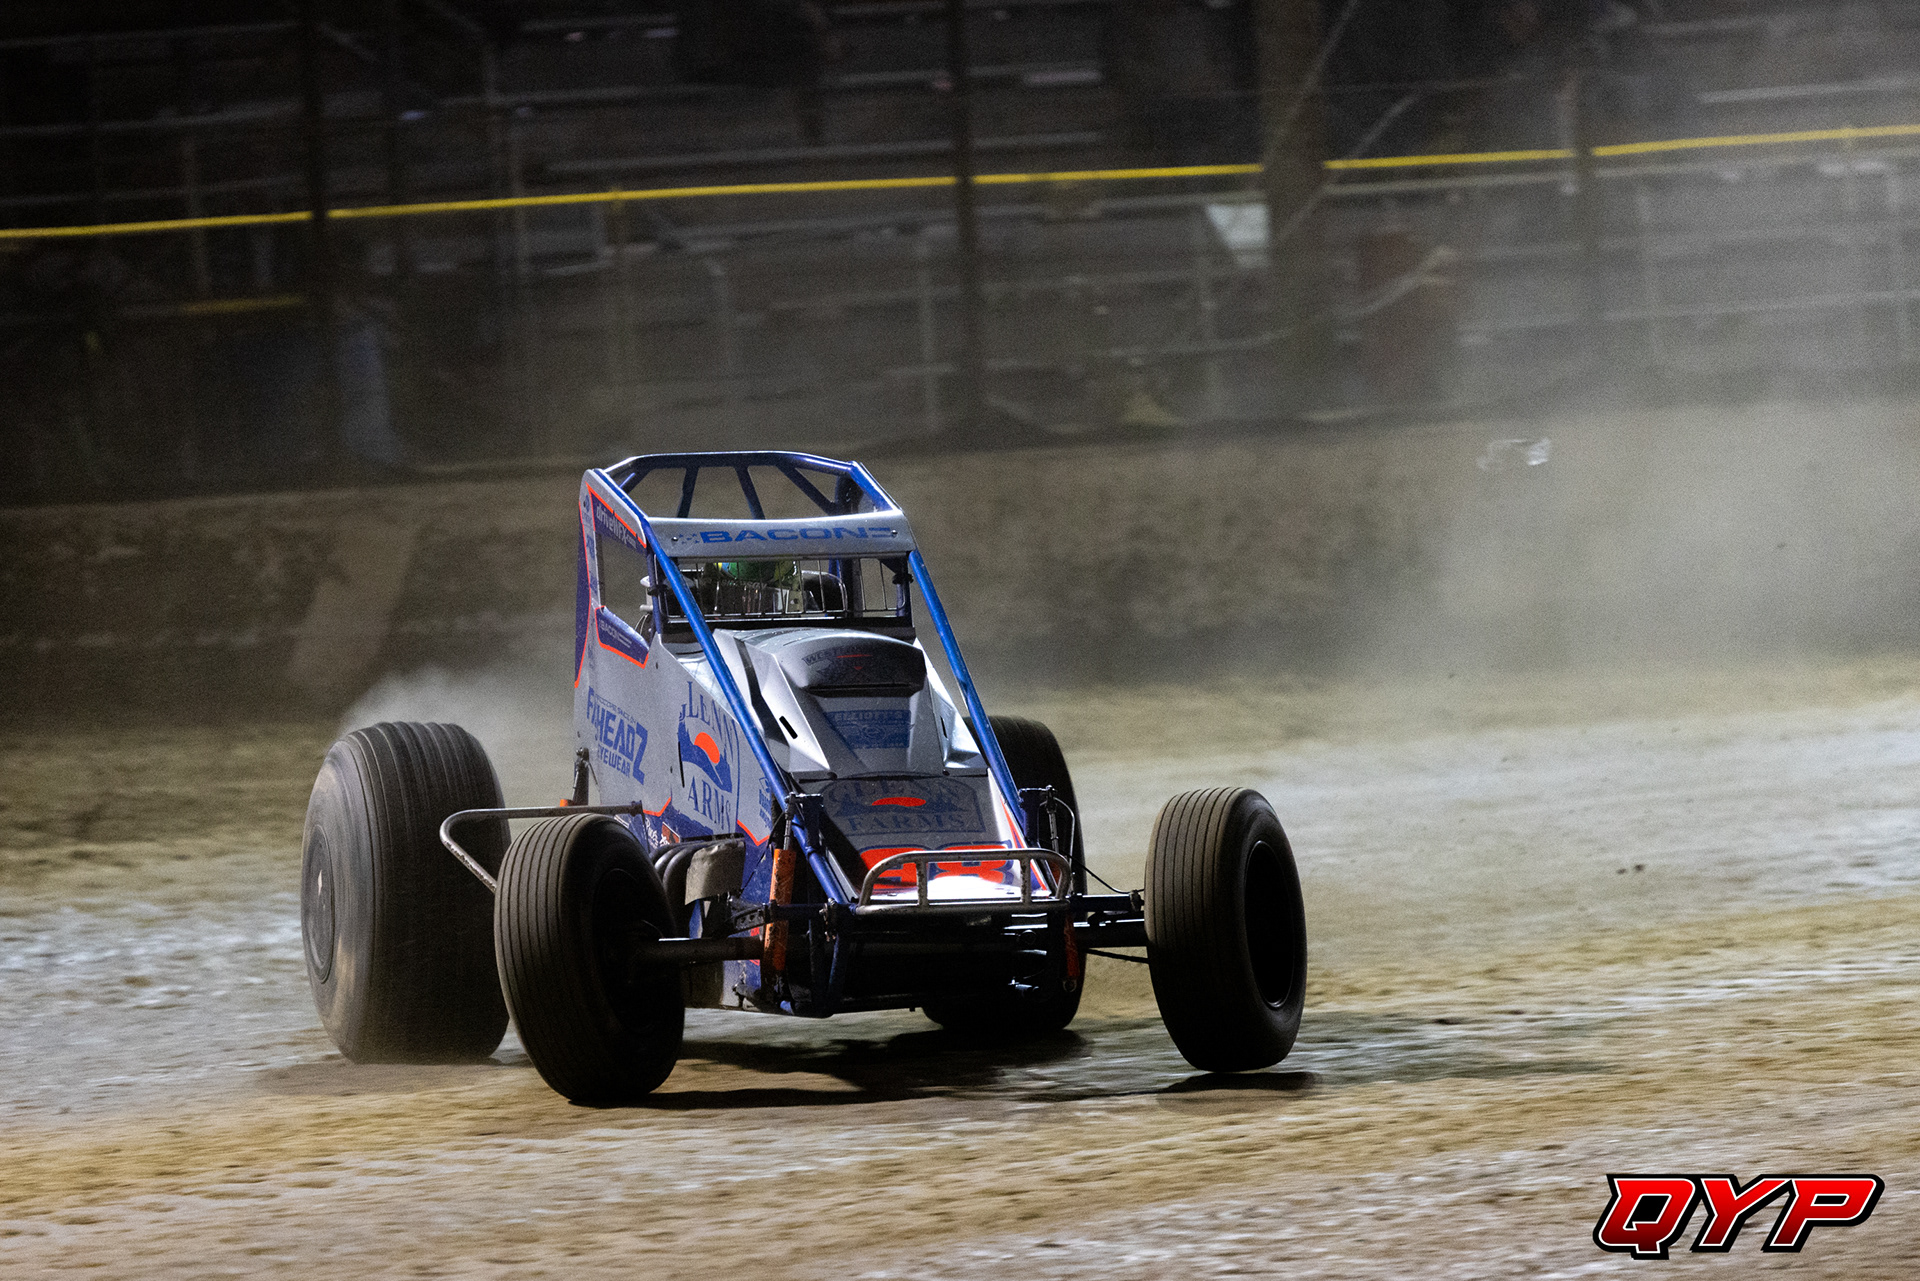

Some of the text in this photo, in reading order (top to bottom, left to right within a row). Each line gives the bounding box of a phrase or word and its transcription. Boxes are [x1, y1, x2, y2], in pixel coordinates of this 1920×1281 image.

[700, 527, 869, 544] BACON
[587, 686, 649, 785] FHEADZ
[848, 813, 966, 832] FARMS
